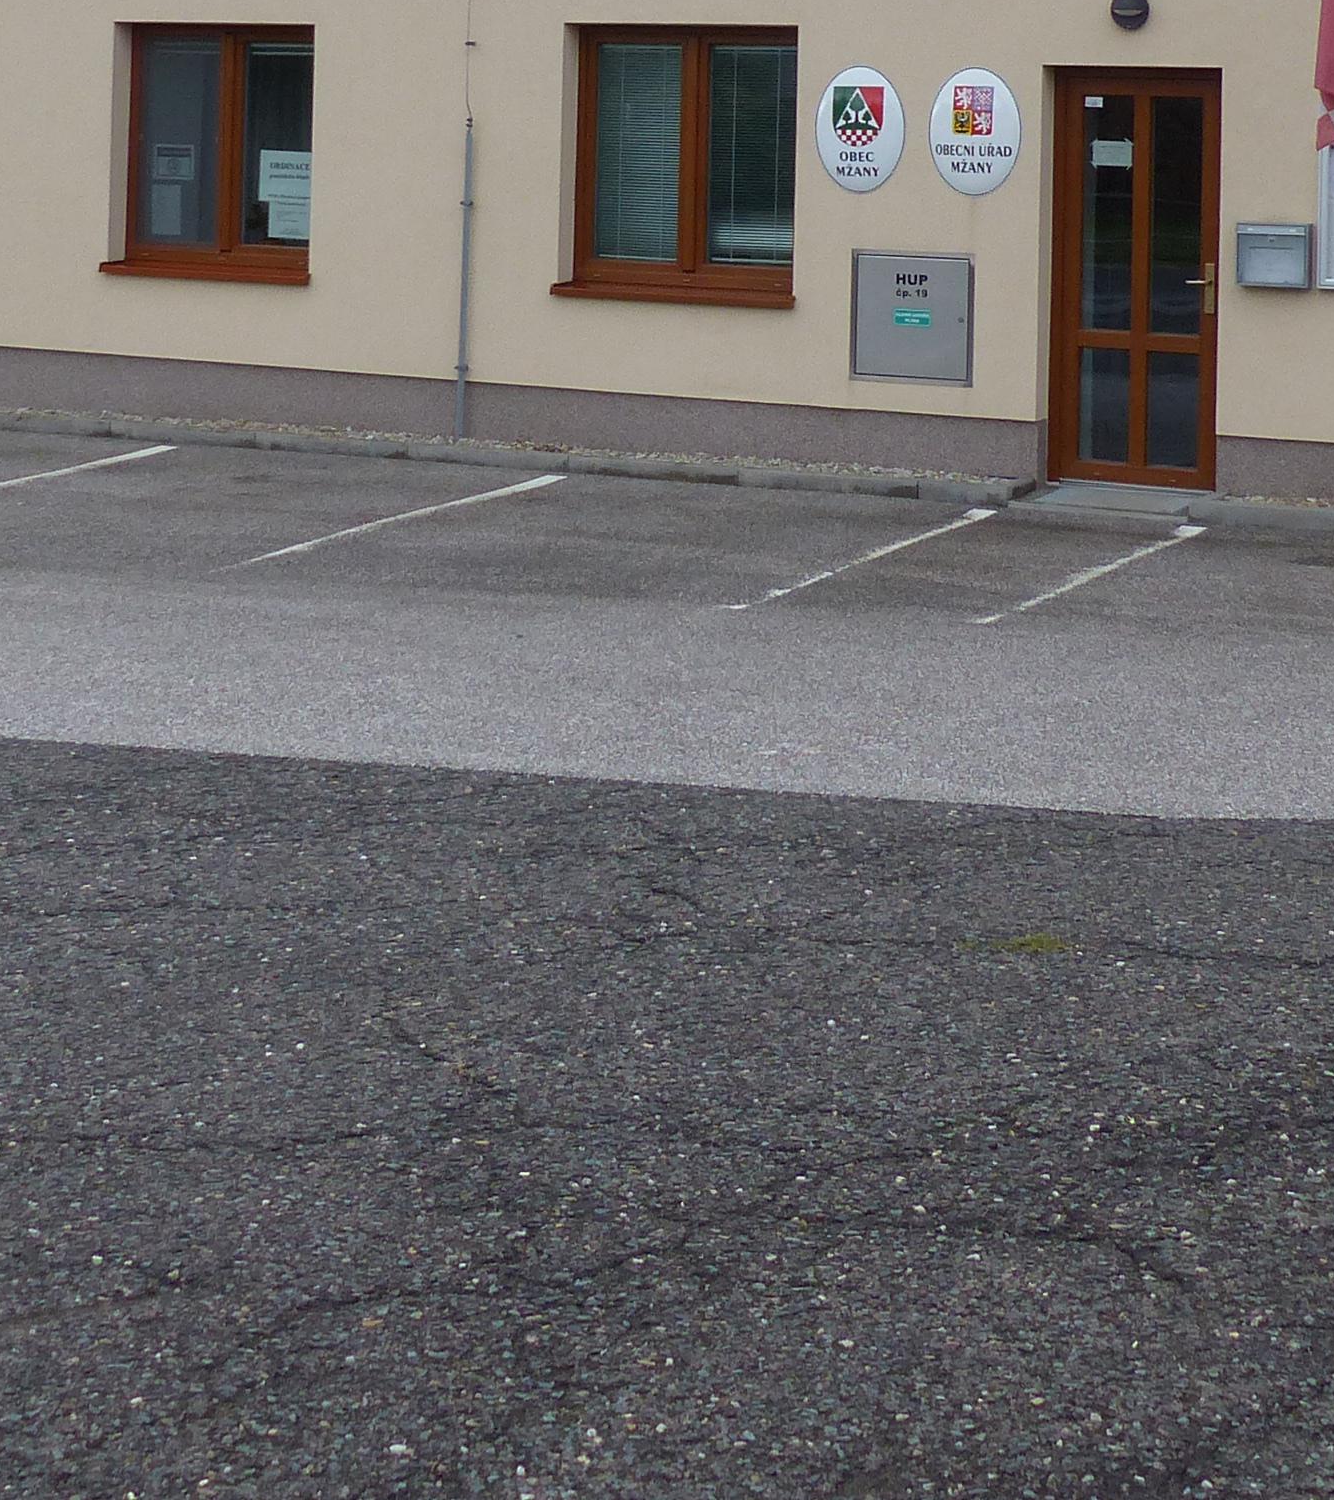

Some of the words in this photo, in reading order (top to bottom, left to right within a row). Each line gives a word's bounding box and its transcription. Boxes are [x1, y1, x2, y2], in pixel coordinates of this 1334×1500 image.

[839, 150, 875, 163] OBEC
[935, 142, 975, 157] OBECNÍ
[979, 142, 1013, 158] ÚŘAD
[836, 163, 880, 177] MŽANY
[950, 159, 993, 174] MŽANY
[896, 273, 929, 286] HUP
